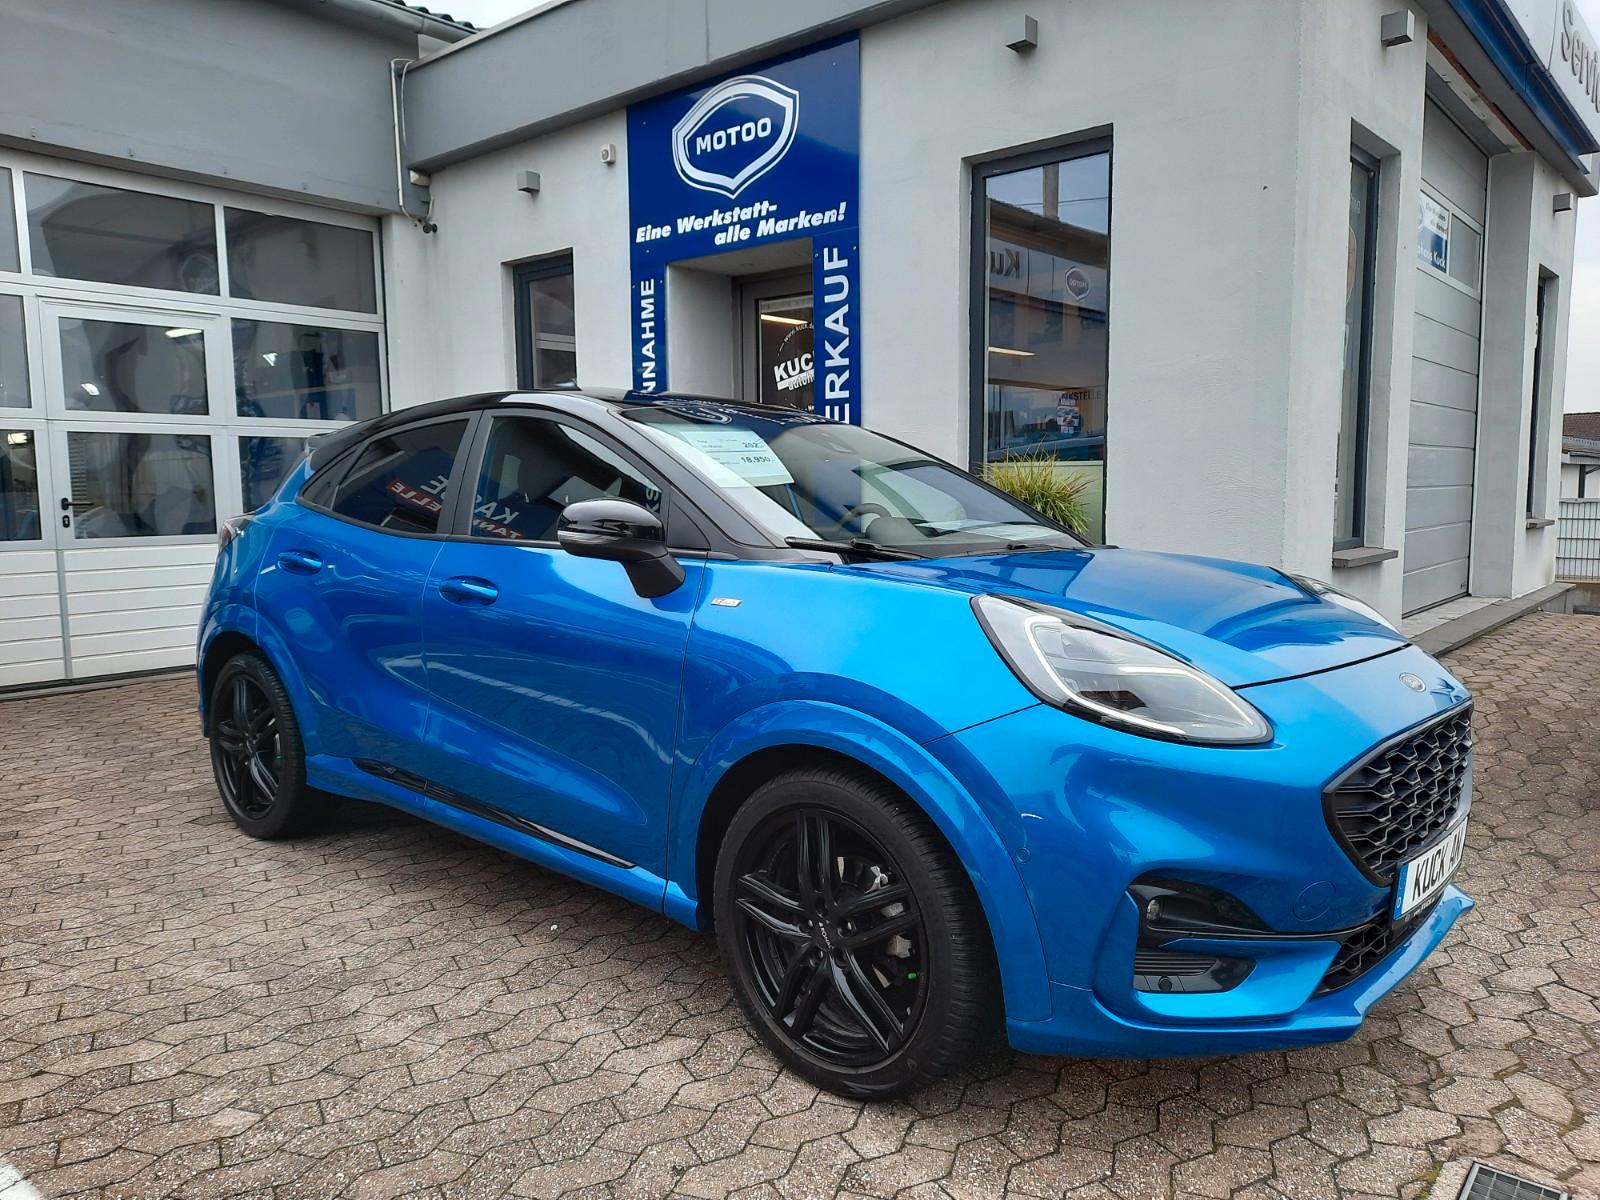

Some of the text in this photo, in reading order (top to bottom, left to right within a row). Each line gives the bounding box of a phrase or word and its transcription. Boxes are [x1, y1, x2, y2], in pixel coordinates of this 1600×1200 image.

[696, 117, 772, 155] MOTOO
[635, 200, 777, 244] Eine Werkstatt-
[714, 201, 847, 245] alle Marken!
[773, 351, 815, 382] KUC
[1412, 841, 1450, 901] KUCK
